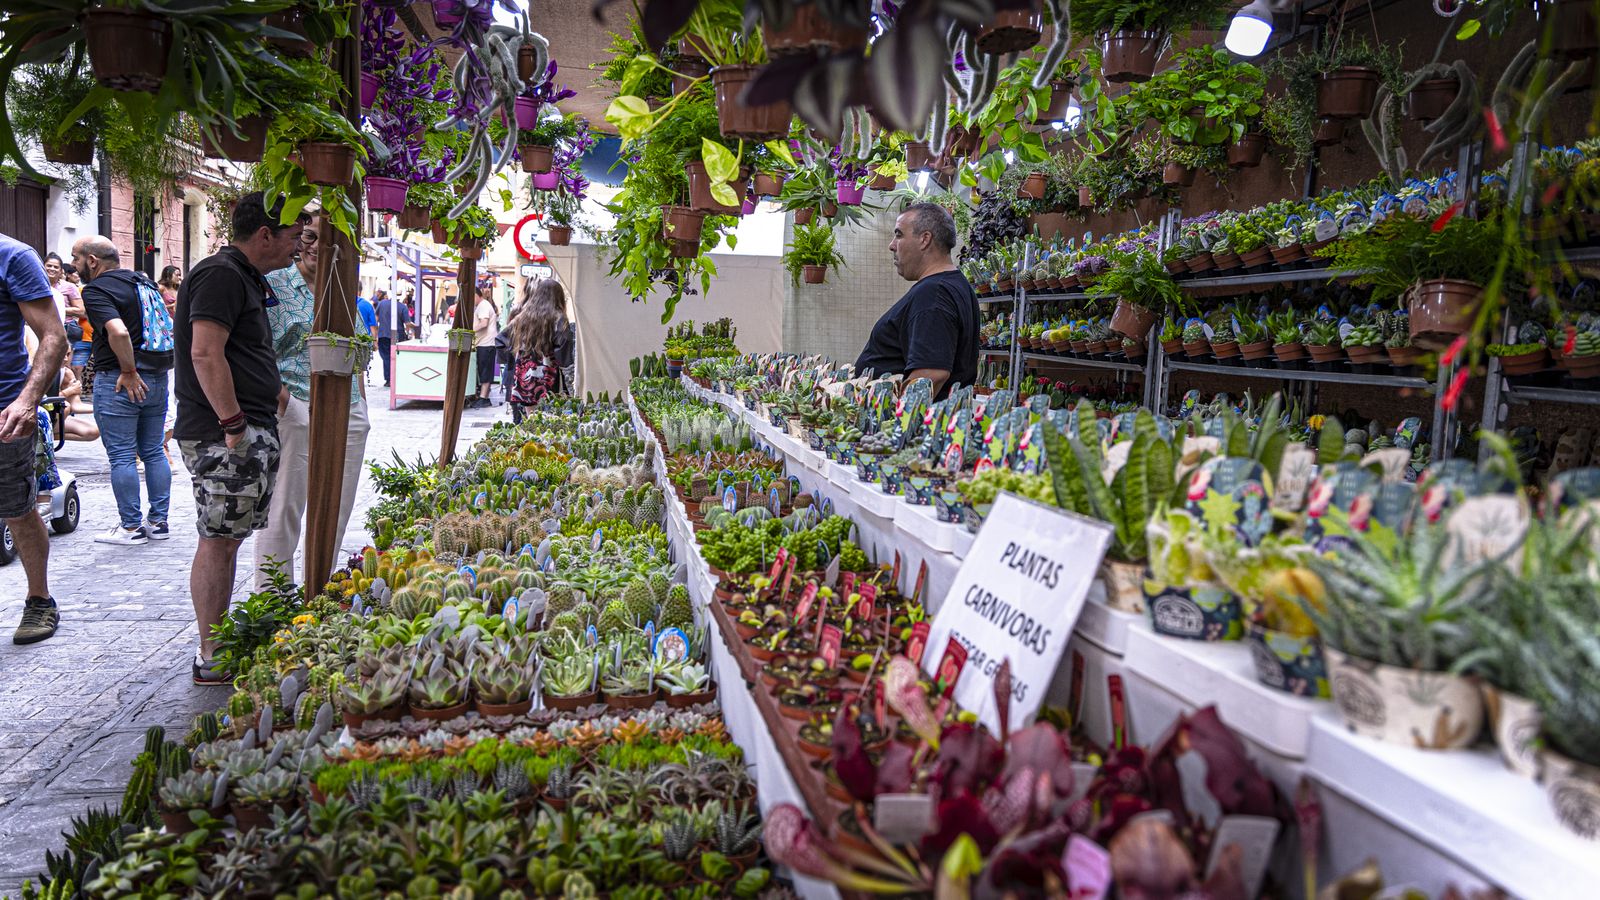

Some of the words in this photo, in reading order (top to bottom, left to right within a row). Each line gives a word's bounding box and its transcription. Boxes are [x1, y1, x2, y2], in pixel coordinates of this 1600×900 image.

[1000, 541, 1064, 590] PLANTAS
[964, 583, 1052, 655] CARNIVORAS
[984, 659, 1029, 703] GRAS
